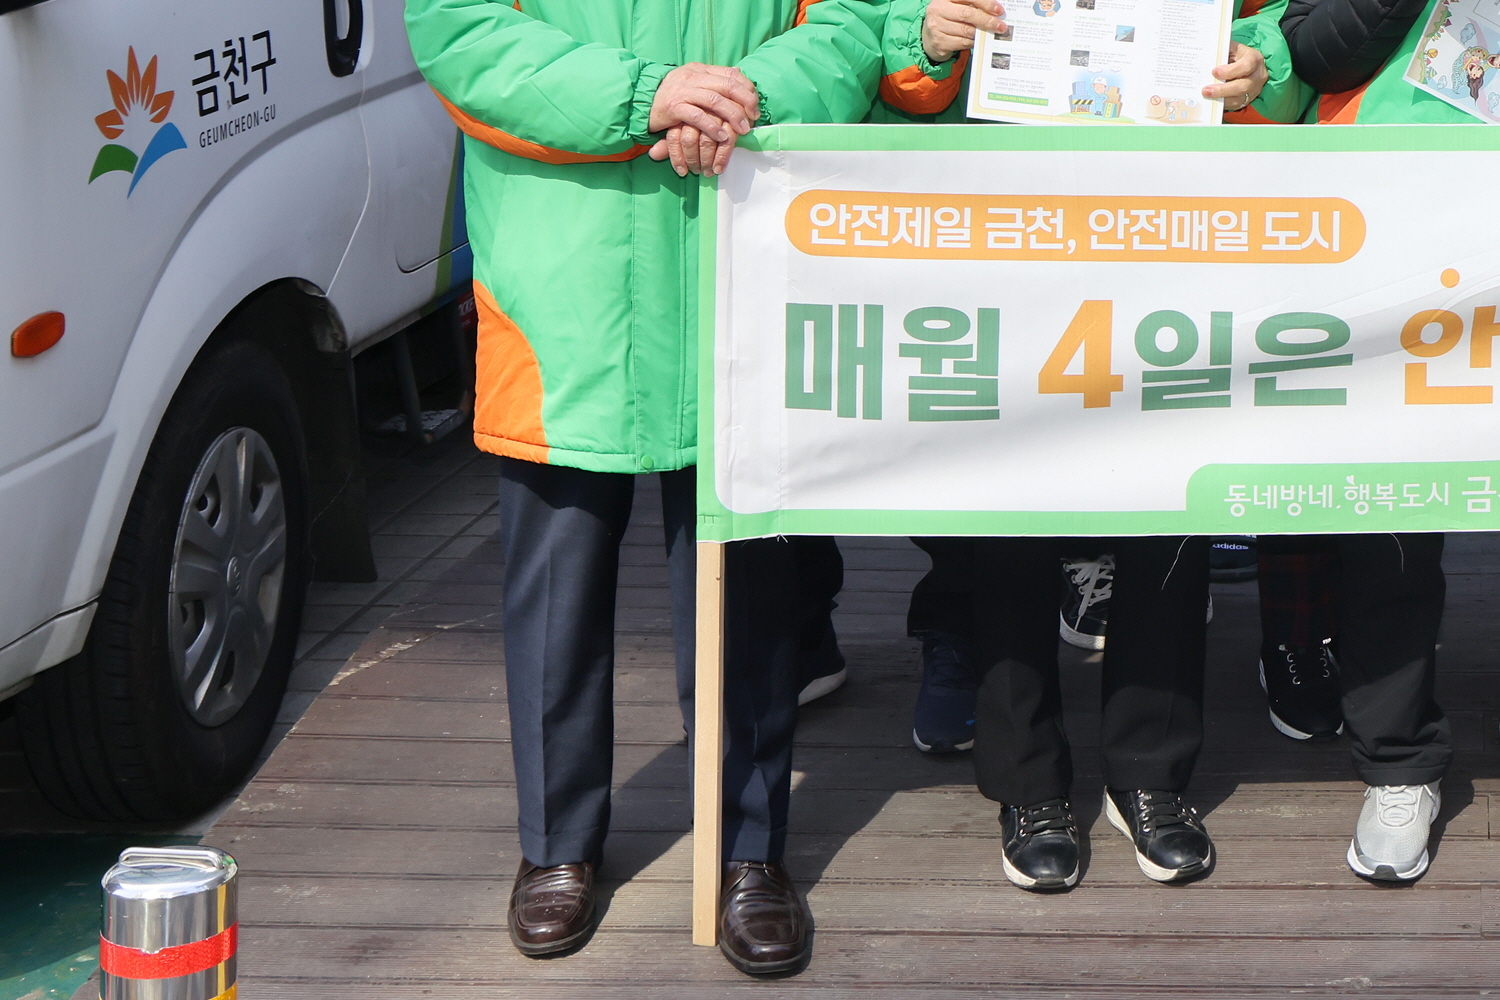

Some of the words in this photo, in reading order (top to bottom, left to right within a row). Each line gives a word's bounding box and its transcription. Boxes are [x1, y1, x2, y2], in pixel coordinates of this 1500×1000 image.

[193, 30, 277, 117] 금천구
[199, 104, 277, 149] GEUMCHEON-GU
[810, 203, 972, 251] 안전제일
[984, 208, 1078, 253] 금천,
[1087, 211, 1250, 253] 안전매일
[1261, 215, 1341, 253] 도시
[785, 301, 1001, 423] 매월
[1037, 299, 1354, 413] 4일은
[1343, 475, 1450, 515] 행복도시
